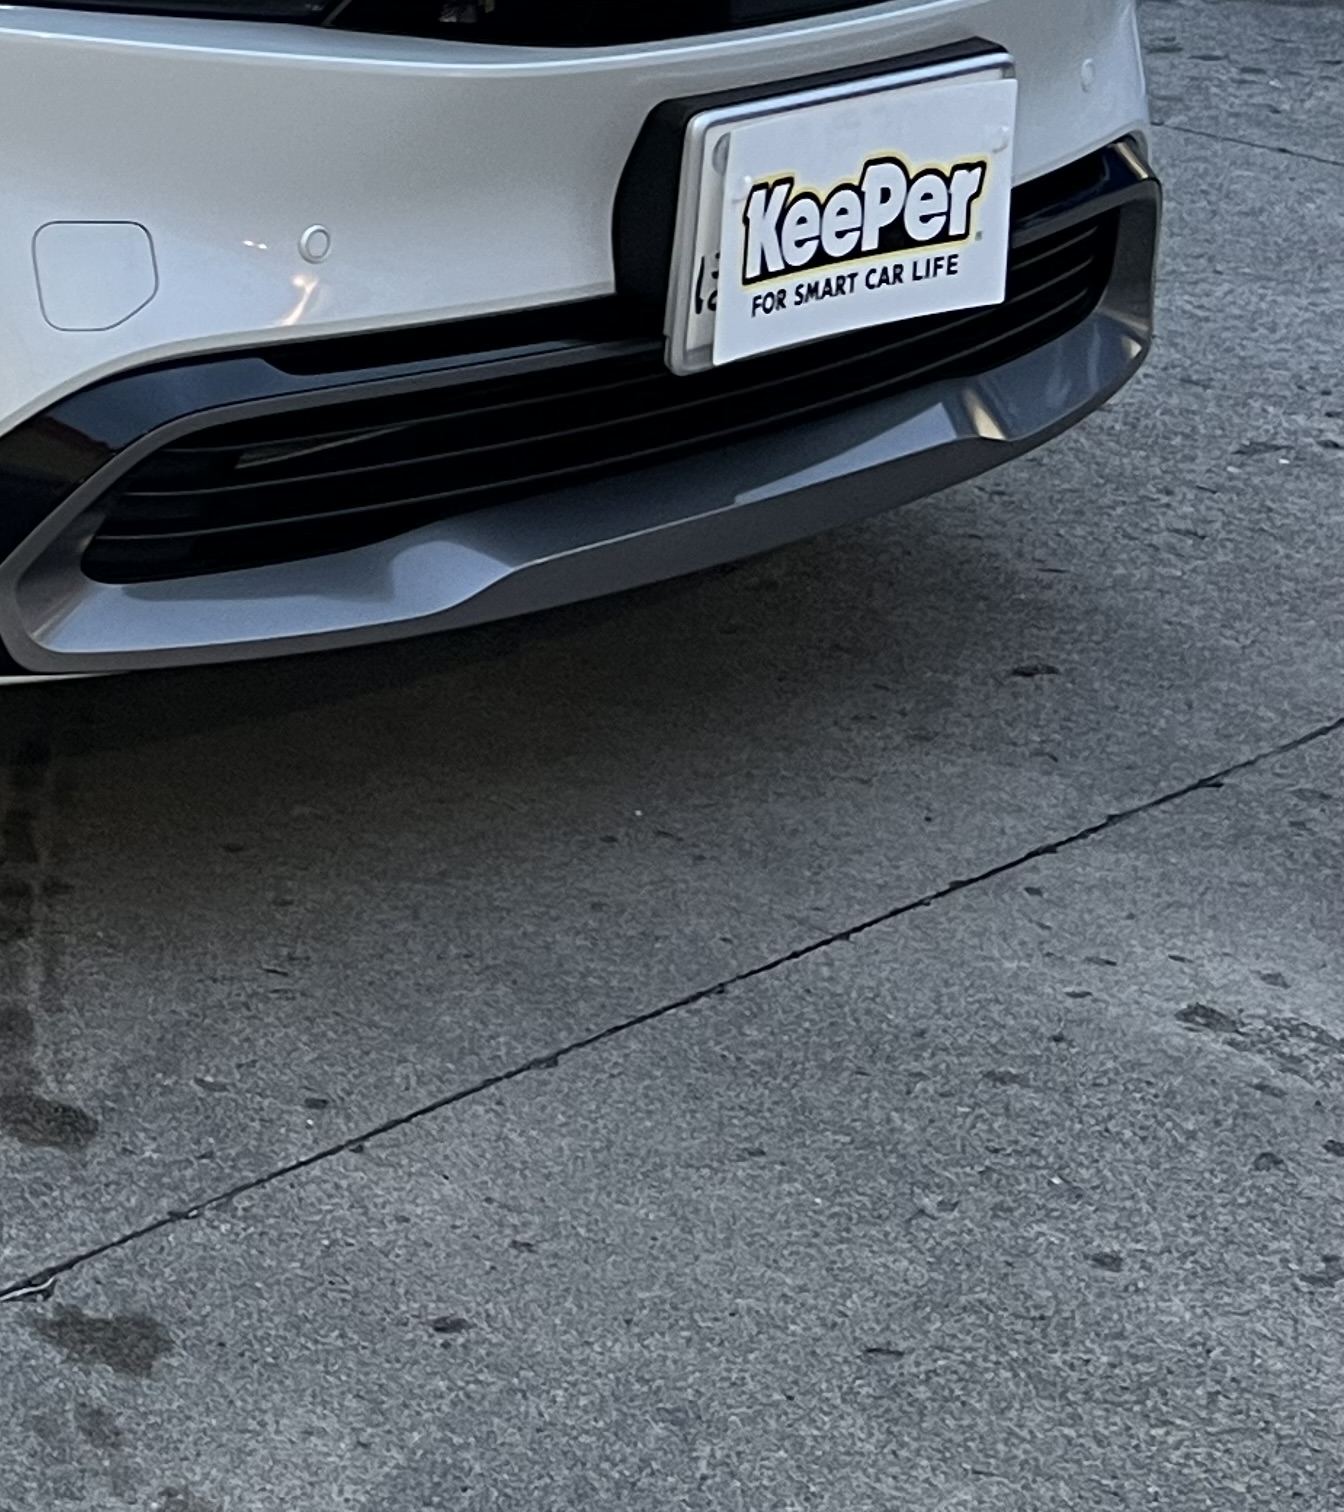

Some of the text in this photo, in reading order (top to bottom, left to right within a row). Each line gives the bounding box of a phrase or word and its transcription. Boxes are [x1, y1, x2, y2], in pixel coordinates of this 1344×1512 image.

[742, 157, 987, 286] KeePer
[751, 253, 960, 318] FOR SMART CAR LIFE
